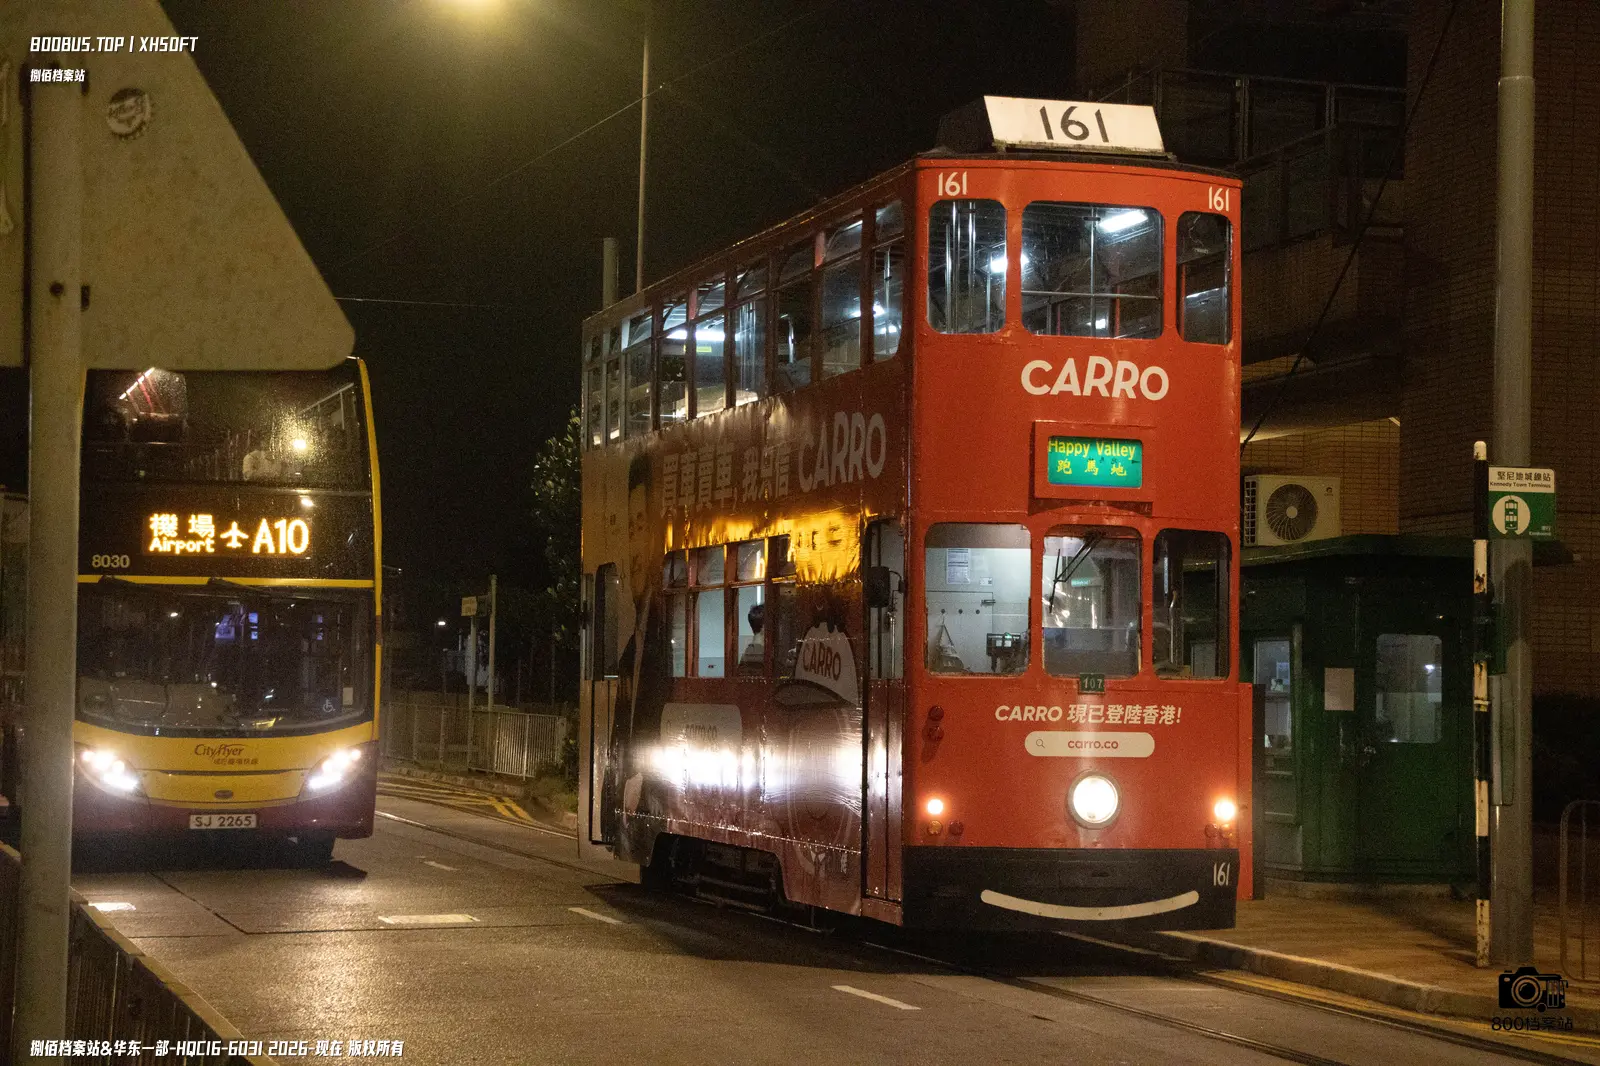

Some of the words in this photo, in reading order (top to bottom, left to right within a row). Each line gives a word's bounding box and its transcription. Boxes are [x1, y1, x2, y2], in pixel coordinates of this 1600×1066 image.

[1039, 105, 1110, 143] 161
[937, 171, 968, 197] 161
[1208, 186, 1230, 212] 161
[1020, 355, 1170, 401] CARRO
[797, 411, 887, 493] CARRO
[1048, 440, 1091, 458] Happy
[1096, 442, 1136, 460] Valley
[1056, 459, 1127, 477] 跑馬地
[150, 514, 215, 538] 機場
[252, 518, 309, 554] A10
[149, 537, 215, 554] Airport
[92, 554, 130, 568] 8030
[802, 641, 842, 682] CARRO
[995, 705, 1063, 721] CARRO
[1067, 703, 1182, 725] 現已登陸香港!
[194, 743, 245, 758] Cityflyer
[1067, 738, 1119, 750] carro.co
[194, 816, 212, 827] SJ
[218, 815, 252, 827] 2265
[1213, 862, 1231, 886] 161
